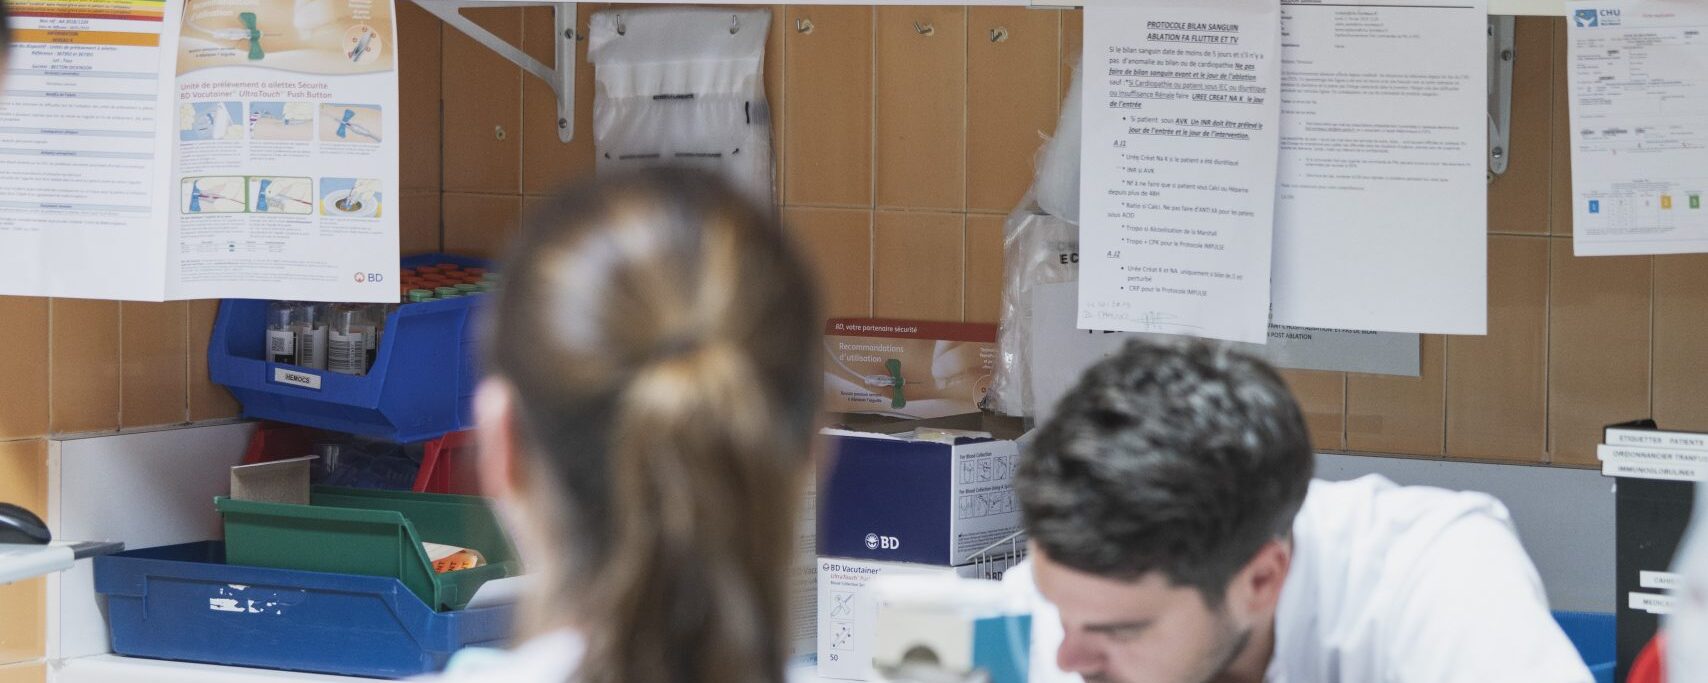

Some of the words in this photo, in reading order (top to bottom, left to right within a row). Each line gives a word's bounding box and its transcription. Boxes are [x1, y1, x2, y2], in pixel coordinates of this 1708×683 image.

[1599, 9, 1620, 17] CHU
[1147, 21, 1186, 30] PROTOCOLE
[1187, 23, 1206, 31] BILAN
[1207, 24, 1239, 32] SANGUIN
[1147, 33, 1180, 41] ABLATION
[1191, 35, 1219, 43] FLUTTER
[200, 81, 211, 89] de
[180, 92, 190, 100] BD
[287, 90, 305, 98] Push
[306, 91, 332, 99] Button
[368, 273, 383, 283] BD
[846, 323, 862, 331] votre
[862, 325, 893, 333] partenaire
[894, 326, 918, 334] sécurité
[1286, 332, 1312, 340] ABLATION
[839, 342, 904, 353] Recommandations
[839, 351, 882, 363] d'utilisation
[1669, 437, 1704, 446] PATIENTS
[880, 535, 900, 549] BD
[831, 563, 841, 572] BD
[830, 653, 839, 662] 50
